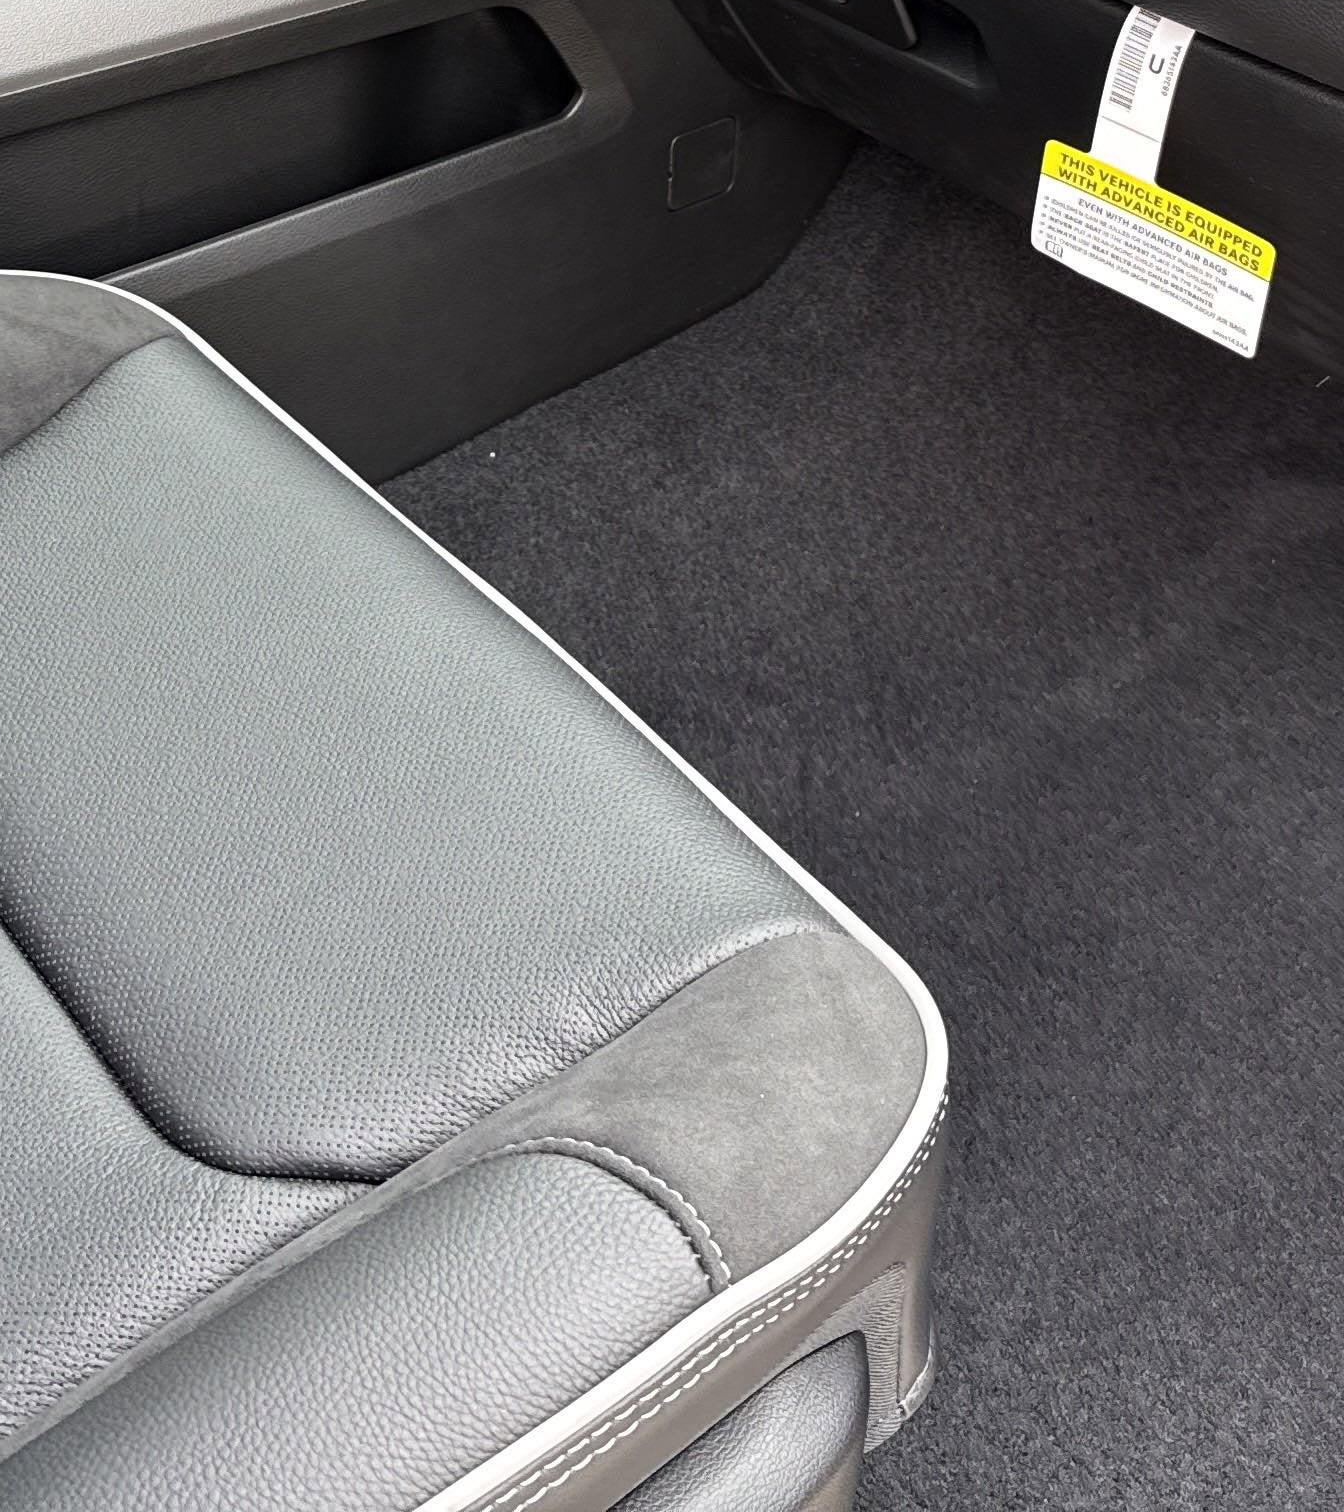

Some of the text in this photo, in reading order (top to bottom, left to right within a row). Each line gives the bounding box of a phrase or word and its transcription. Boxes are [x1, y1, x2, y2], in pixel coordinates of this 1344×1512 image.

[1057, 164, 1260, 272] WITH ADVANCED AIR BAGS
[1060, 151, 1264, 258] THIS VEHICLE IS EQUIPPED
[1077, 196, 1228, 277] EVEN WITH ADVANCED AIR BAGS
